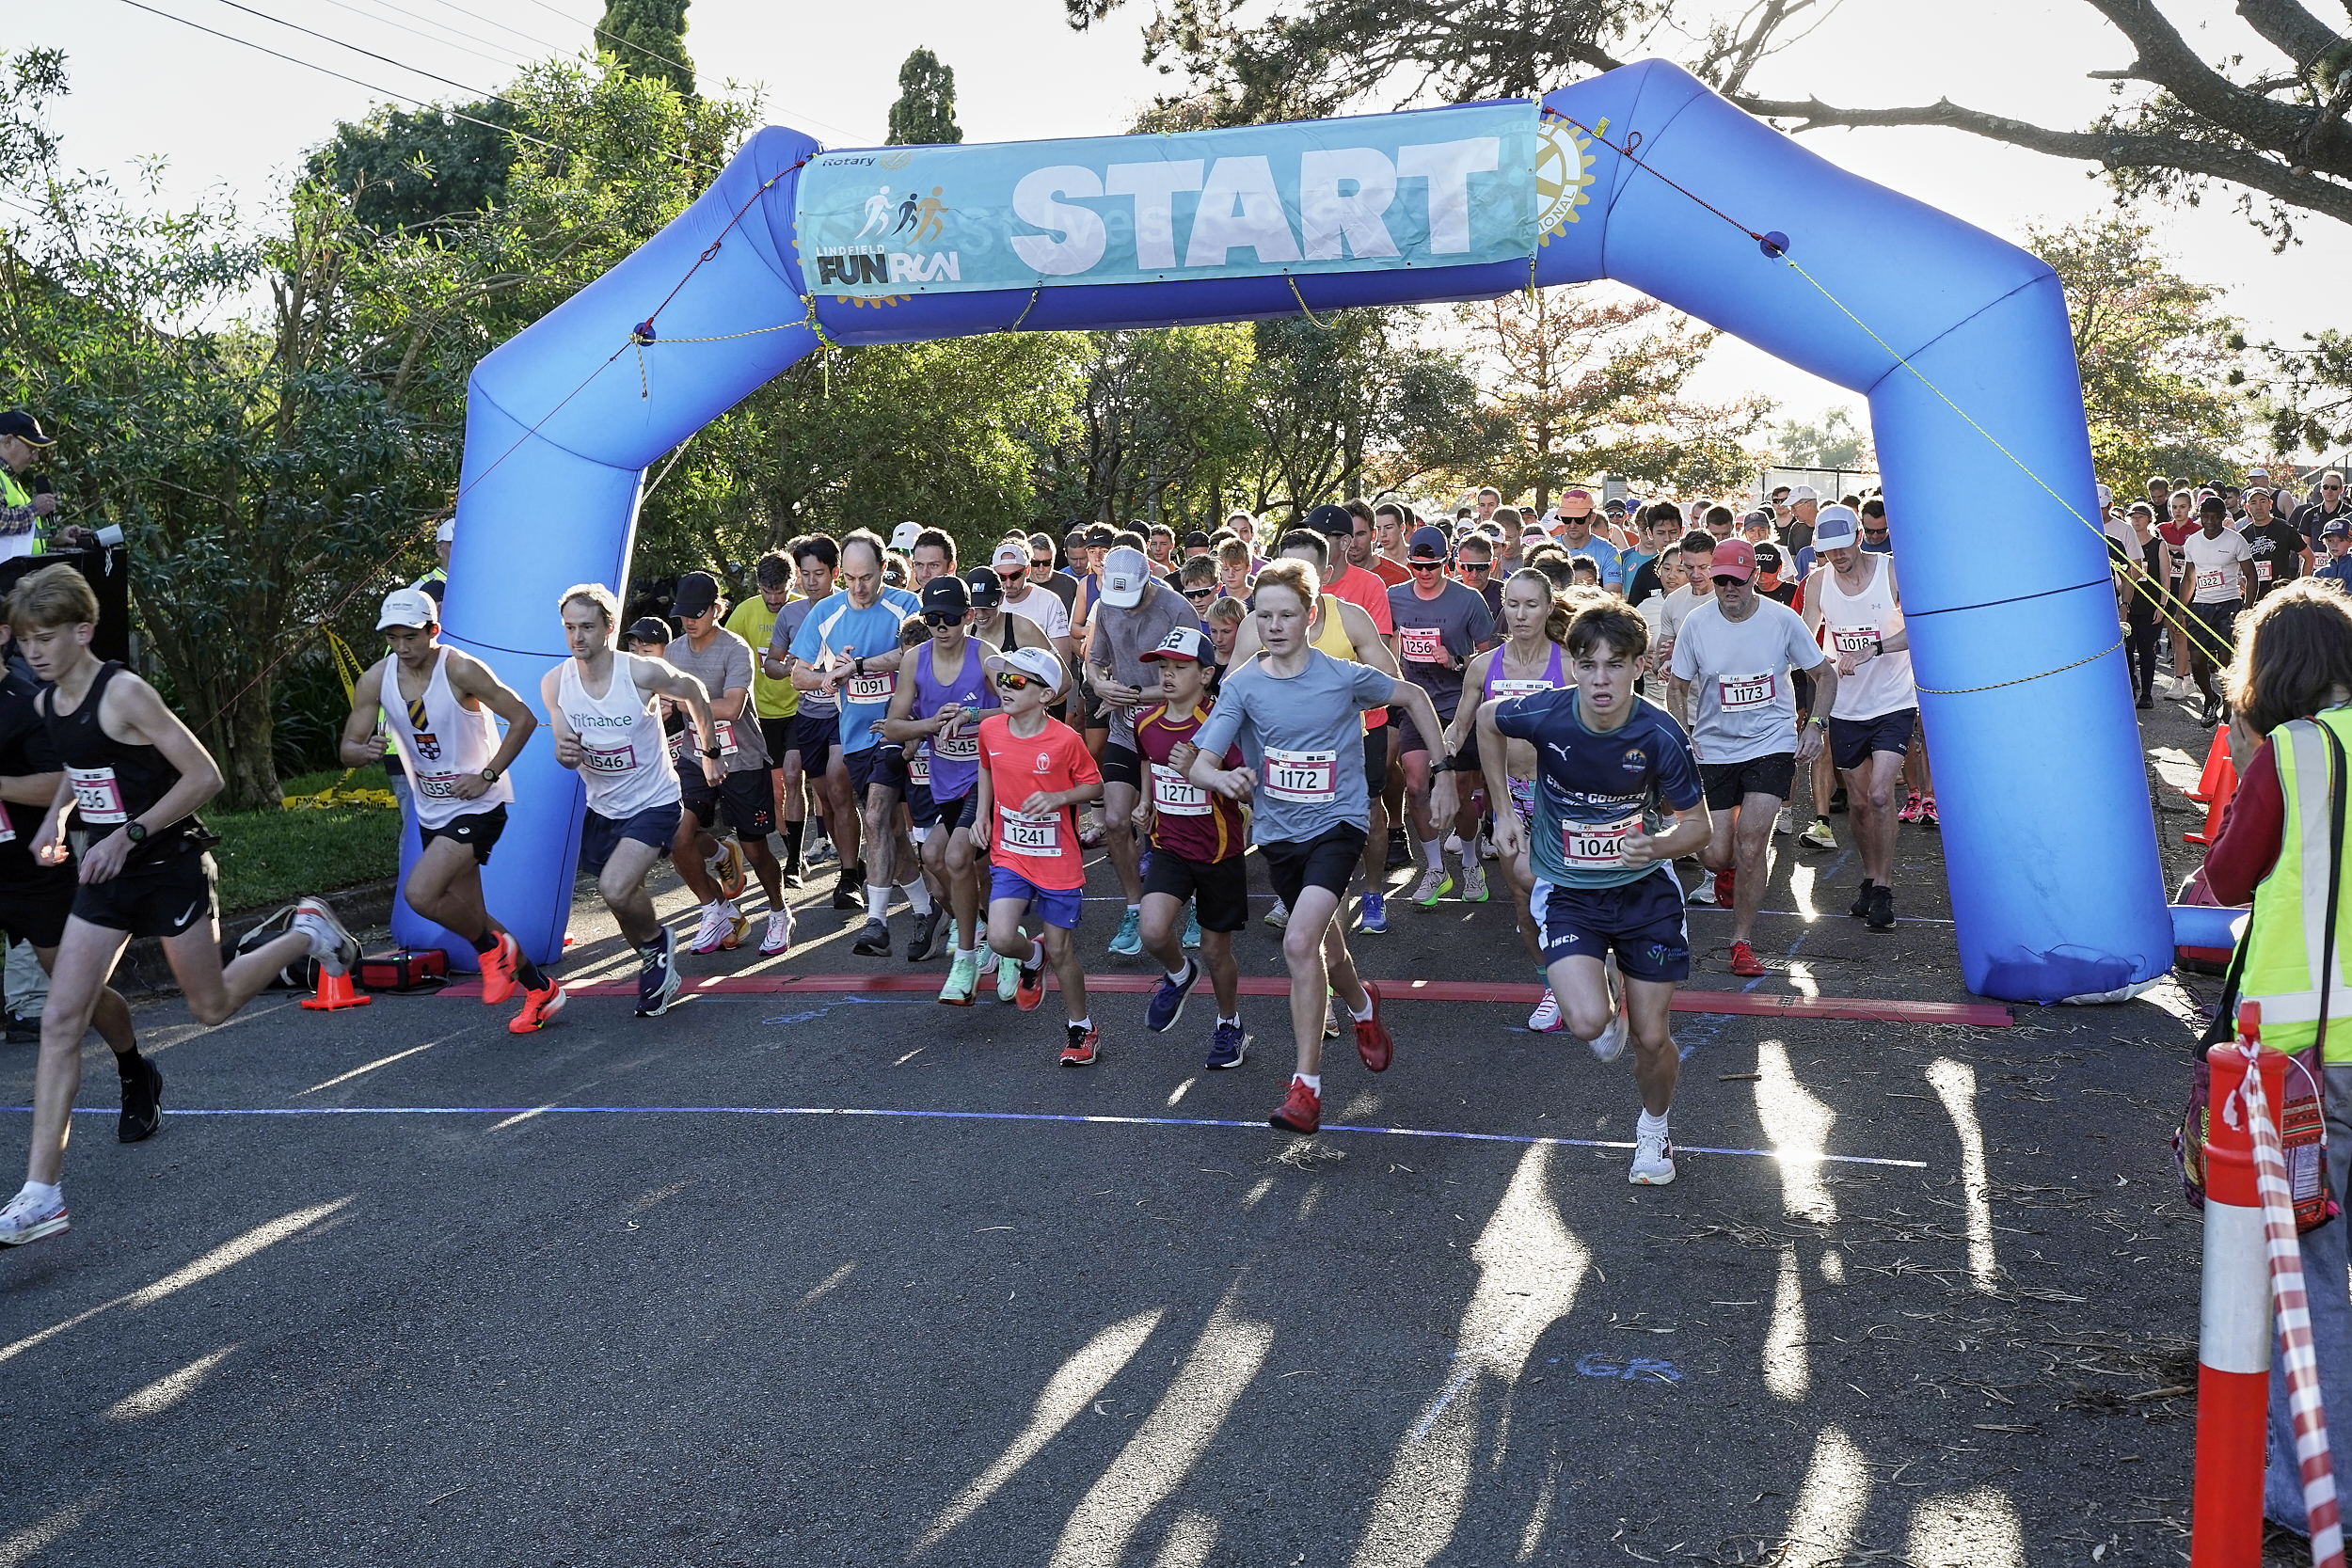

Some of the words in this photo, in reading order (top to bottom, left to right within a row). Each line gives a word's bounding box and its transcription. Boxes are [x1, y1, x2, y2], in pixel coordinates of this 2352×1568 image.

[823, 157, 876, 166] Rotary
[1009, 137, 1501, 276] START
[817, 245, 885, 256] LINDFIELD
[817, 254, 889, 285] FUN
[888, 251, 961, 282] RUN
[2200, 577, 2217, 587] 1322
[1406, 641, 1431, 654] 1256
[1842, 638, 1869, 650] 1018
[854, 679, 884, 694] 1091
[1733, 687, 1763, 702] 1173
[570, 713, 632, 728] fitnance
[947, 740, 977, 753] 545
[588, 755, 624, 768] 1546
[1279, 769, 1317, 789] 1172
[1162, 784, 1195, 802] 1271
[1011, 827, 1044, 845] 1241
